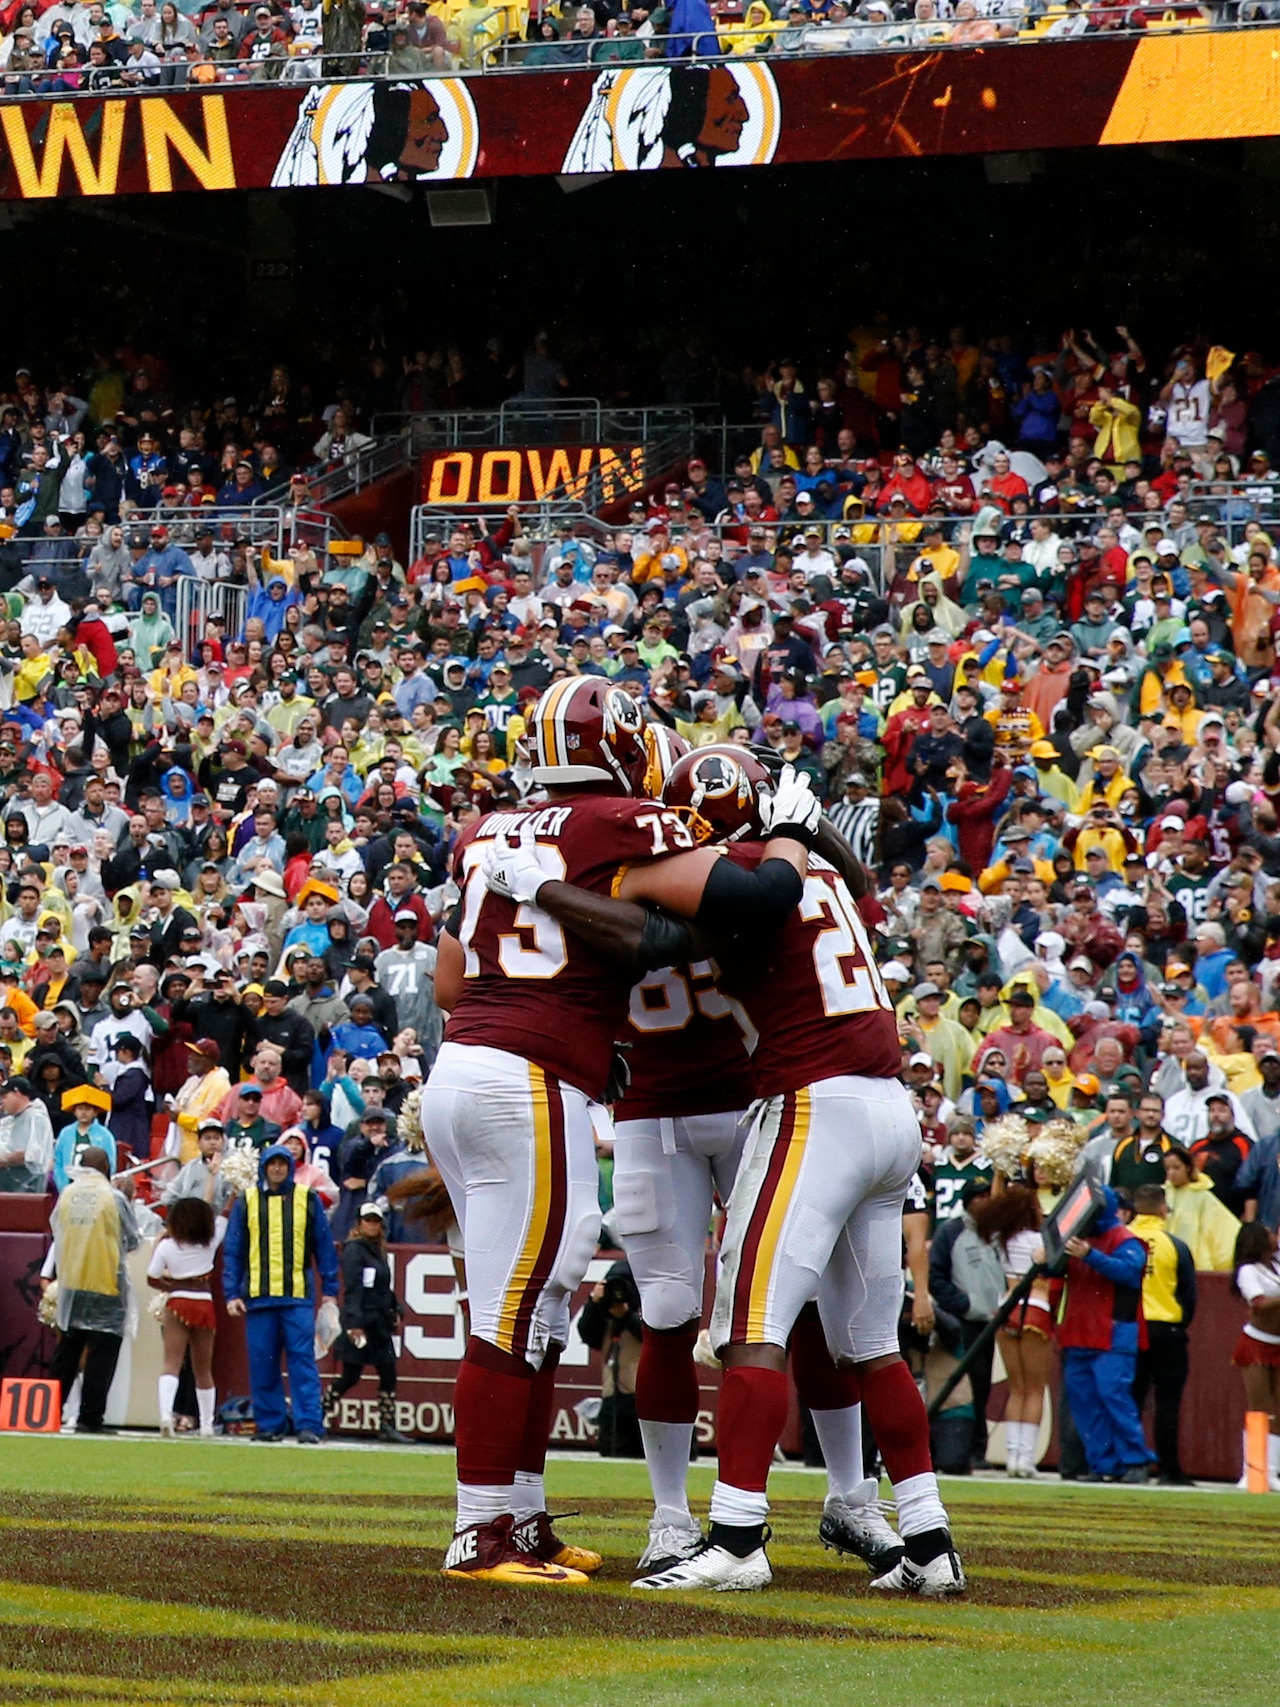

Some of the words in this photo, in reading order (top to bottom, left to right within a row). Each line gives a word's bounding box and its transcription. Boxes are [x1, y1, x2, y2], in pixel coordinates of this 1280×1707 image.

[427, 448, 644, 505] DOWN
[635, 811, 694, 856] 73
[388, 963, 420, 996] 71
[6, 1382, 52, 1430] 10
